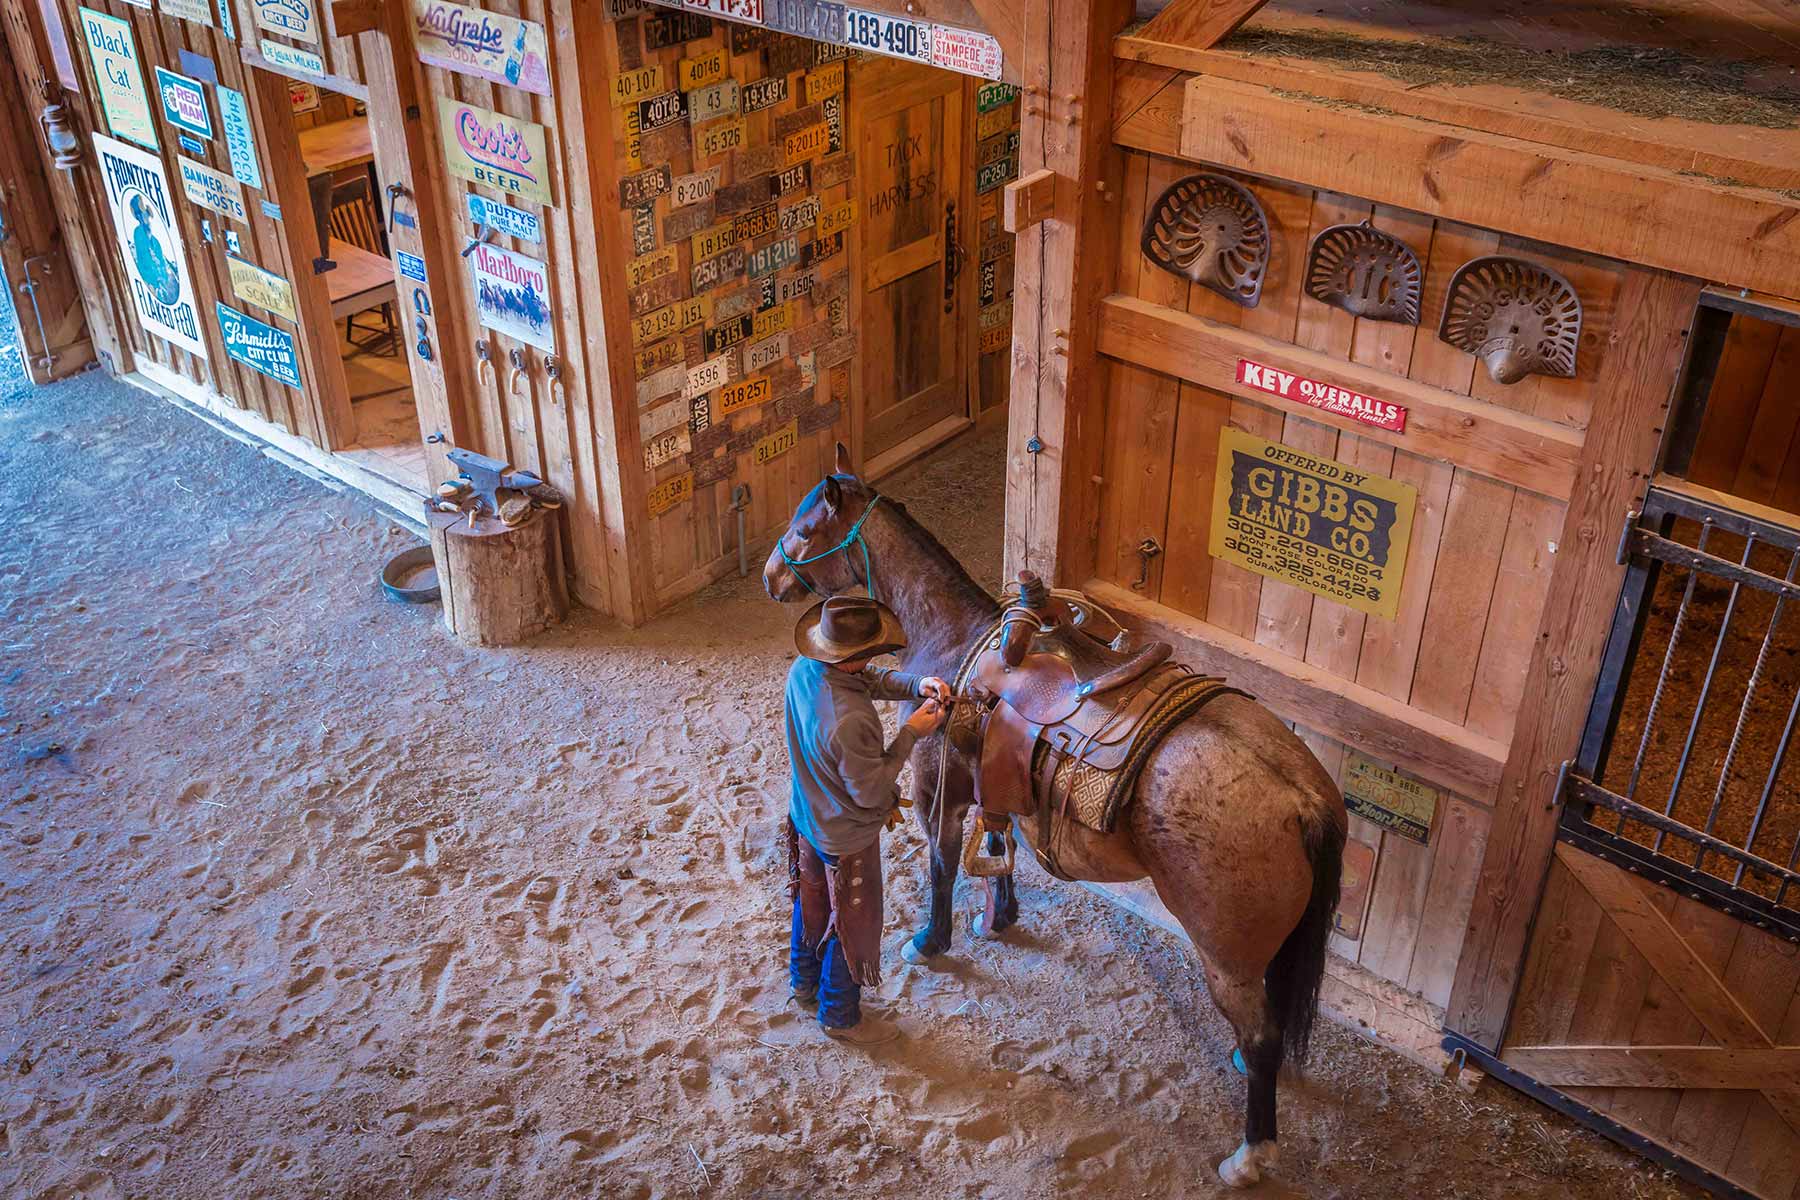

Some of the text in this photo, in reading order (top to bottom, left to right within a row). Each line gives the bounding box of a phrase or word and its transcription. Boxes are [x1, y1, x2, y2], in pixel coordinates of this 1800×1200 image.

[88, 20, 132, 59] Black
[416, 2, 502, 52] NuGrape
[847, 12, 918, 57] 183-490
[917, 50, 929, 60] 22
[935, 40, 980, 62] STAMPEDE
[105, 58, 131, 89] Cat
[617, 68, 656, 97] 40-107
[690, 57, 720, 81] 40T46
[175, 86, 200, 106] RED
[648, 96, 680, 121] 40T46
[179, 102, 204, 122] MAN
[224, 113, 243, 180] TOBACCO
[226, 91, 254, 185] SHAMROCK
[884, 133, 922, 168] TACK
[103, 151, 171, 229] FRONTIER
[183, 165, 223, 193] BANNER
[474, 167, 520, 192] BEER
[869, 170, 937, 219] HARNESS
[206, 190, 243, 217] POSTS
[486, 201, 536, 228] DUFFY'S
[490, 214, 534, 236] PURE MALT
[475, 245, 543, 293] Marlboro
[134, 278, 198, 342] FLAKED FEED
[224, 321, 292, 352] Schmidt's
[247, 345, 290, 364] CITY CLUB
[272, 361, 295, 379] BEER
[1244, 362, 1398, 419] KEY OVERALLS
[1305, 392, 1323, 408] The
[1357, 406, 1390, 425] Finest
[1264, 445, 1368, 488] OFFERED BY
[1248, 467, 1378, 532] GIBBS
[1240, 494, 1376, 562] LAND CO.
[1246, 556, 1353, 600] OURAY, COLORADO
[1306, 558, 1368, 584] COLORADO
